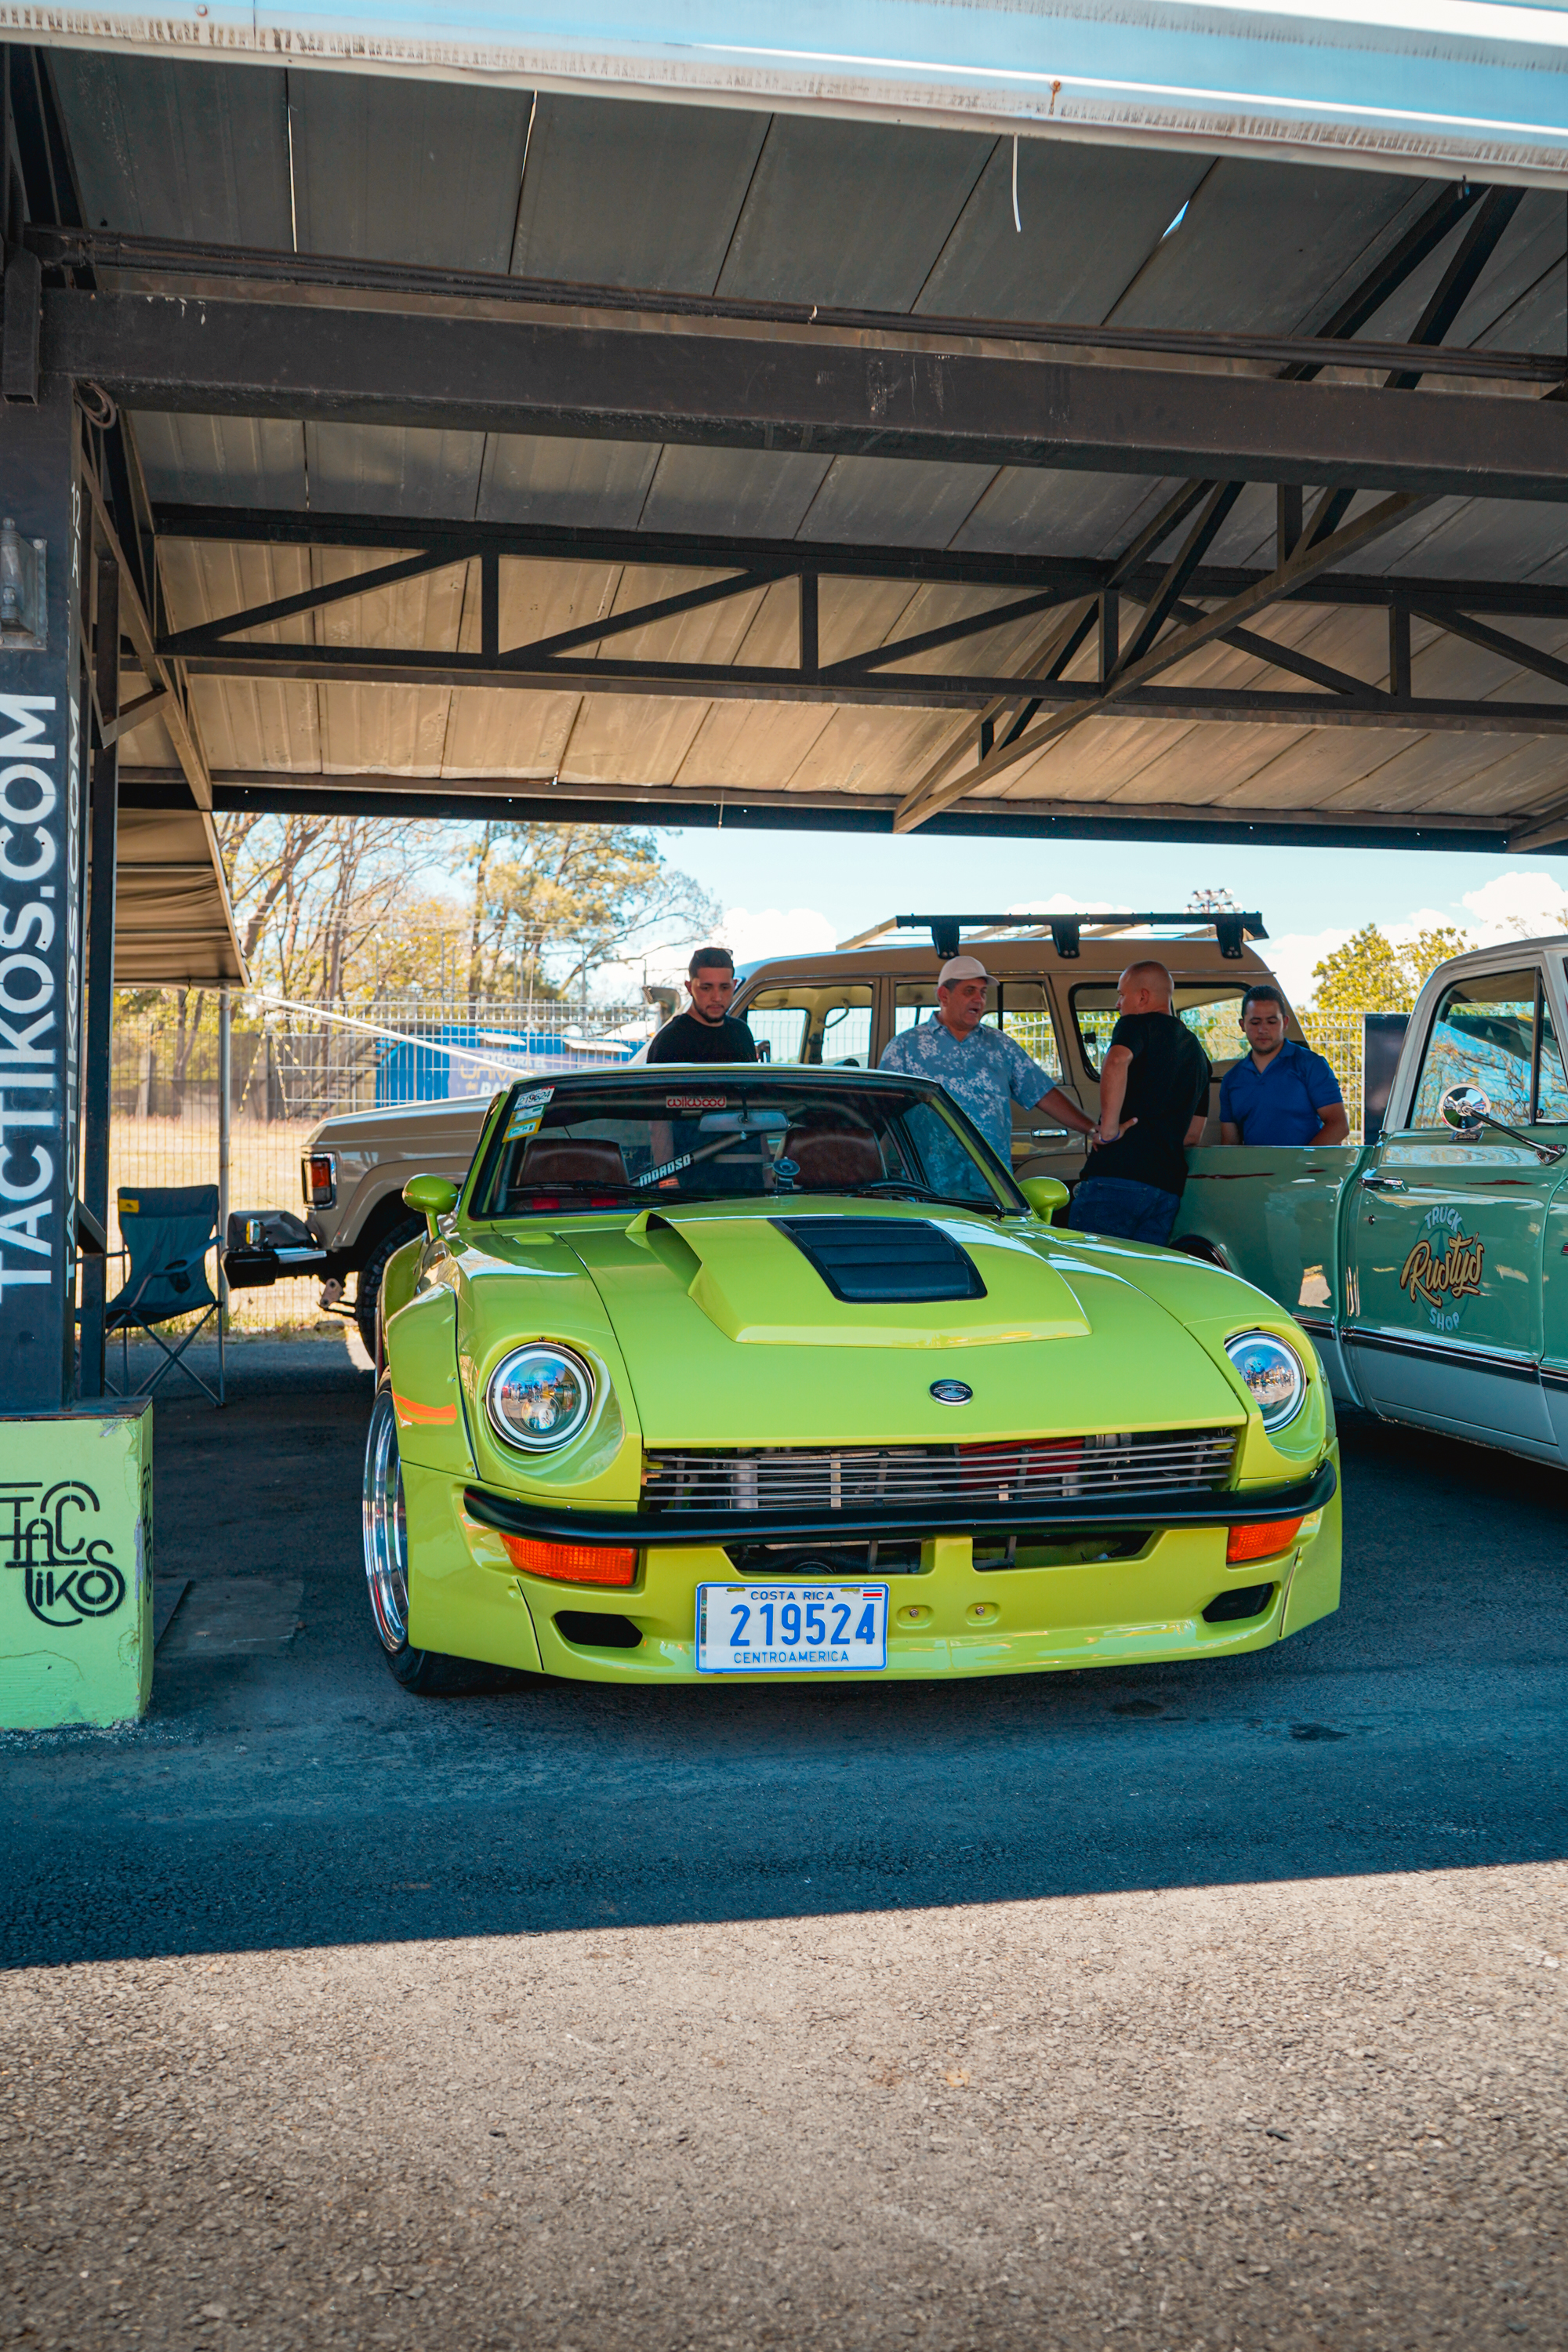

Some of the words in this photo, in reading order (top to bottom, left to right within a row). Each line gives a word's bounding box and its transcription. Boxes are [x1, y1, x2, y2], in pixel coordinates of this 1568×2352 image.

[0, 695, 56, 1303] TACTIKOS.COM
[66, 696, 80, 1298] TACTIKOS.COM
[666, 1096, 726, 1107] wilwood
[639, 1153, 691, 1187] MOROSO
[1424, 1206, 1463, 1233] TRUCK
[1399, 1232, 1485, 1308] Rusty's
[1428, 1307, 1460, 1332] SHOP
[750, 1591, 797, 1600] COSTA
[803, 1591, 835, 1600] RICA
[730, 1603, 876, 1646] 219524
[734, 1650, 850, 1664] CENTROAMERICA
